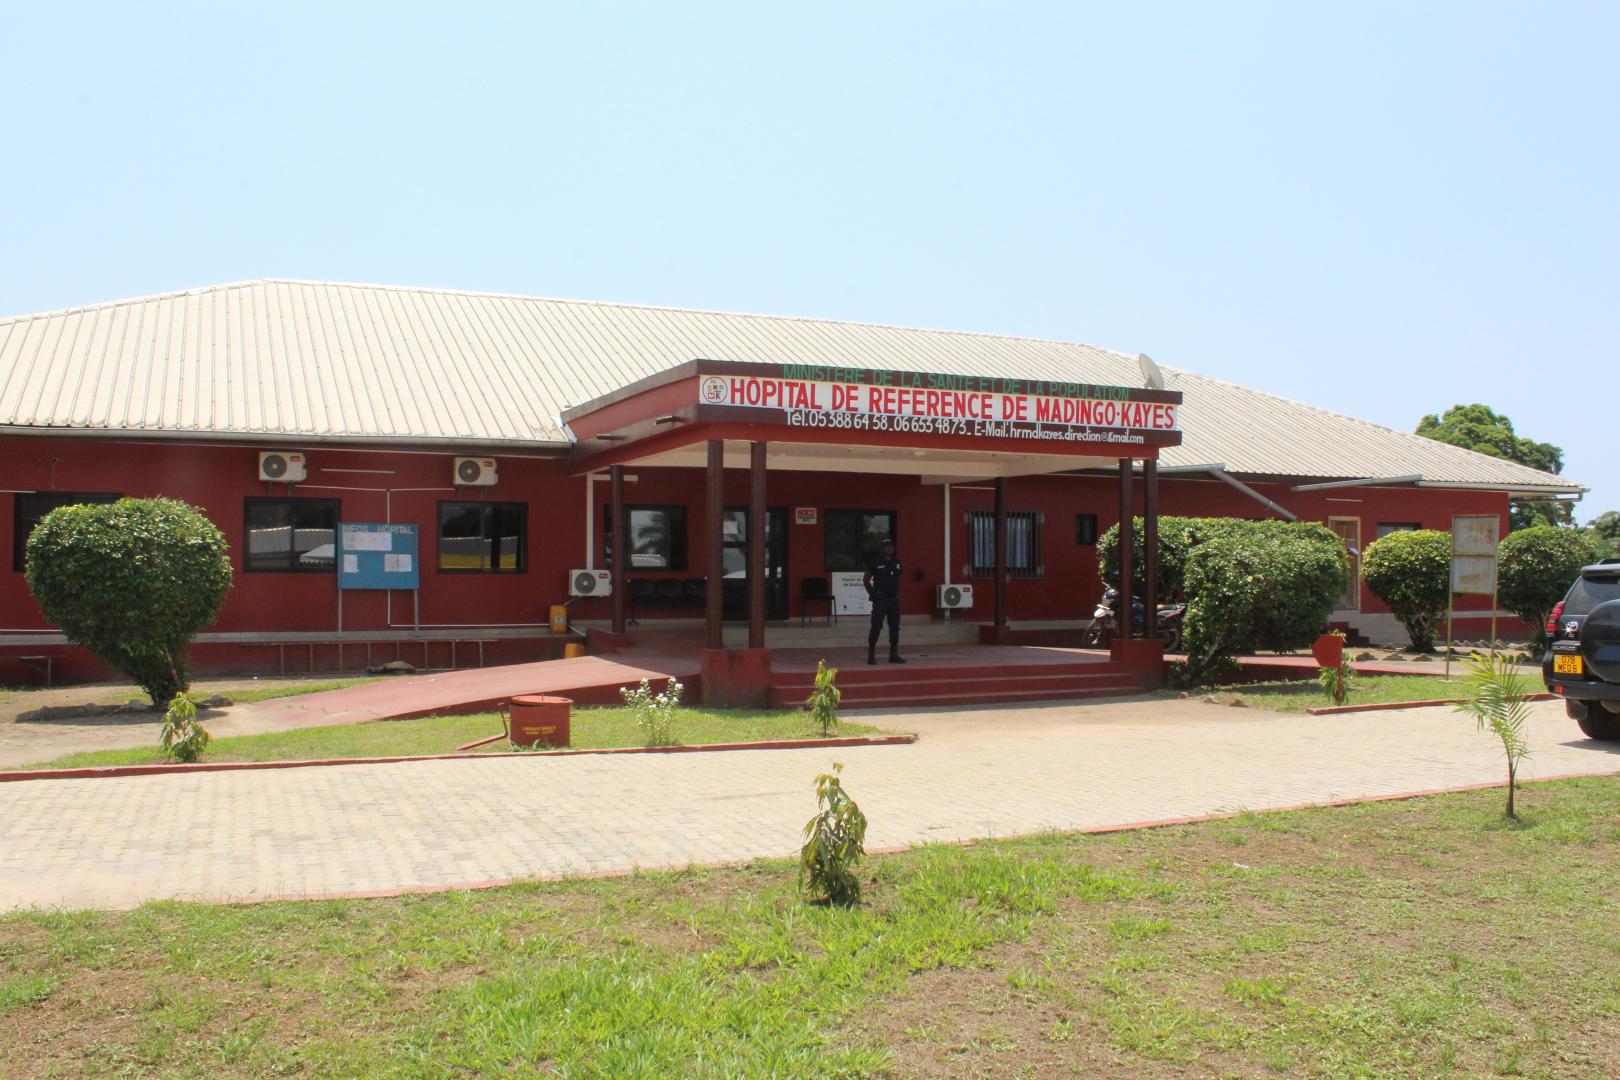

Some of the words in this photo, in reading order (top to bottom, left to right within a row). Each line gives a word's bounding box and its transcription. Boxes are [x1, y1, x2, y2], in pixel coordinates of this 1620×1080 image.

[730, 376, 823, 410] HÔPITAL
[831, 384, 859, 412] DE
[868, 387, 993, 420] REFERENCE
[1002, 396, 1027, 421] DE
[783, 364, 865, 386] MINISTERE
[872, 369, 893, 387] DE
[901, 371, 921, 388] LA
[927, 373, 975, 391] SANTE
[979, 377, 996, 392] ET
[1002, 379, 1021, 395] DE
[1027, 381, 1043, 396] LA
[1049, 382, 1130, 402] POPULATION
[828, 411, 852, 428] 388
[853, 413, 869, 430] 64
